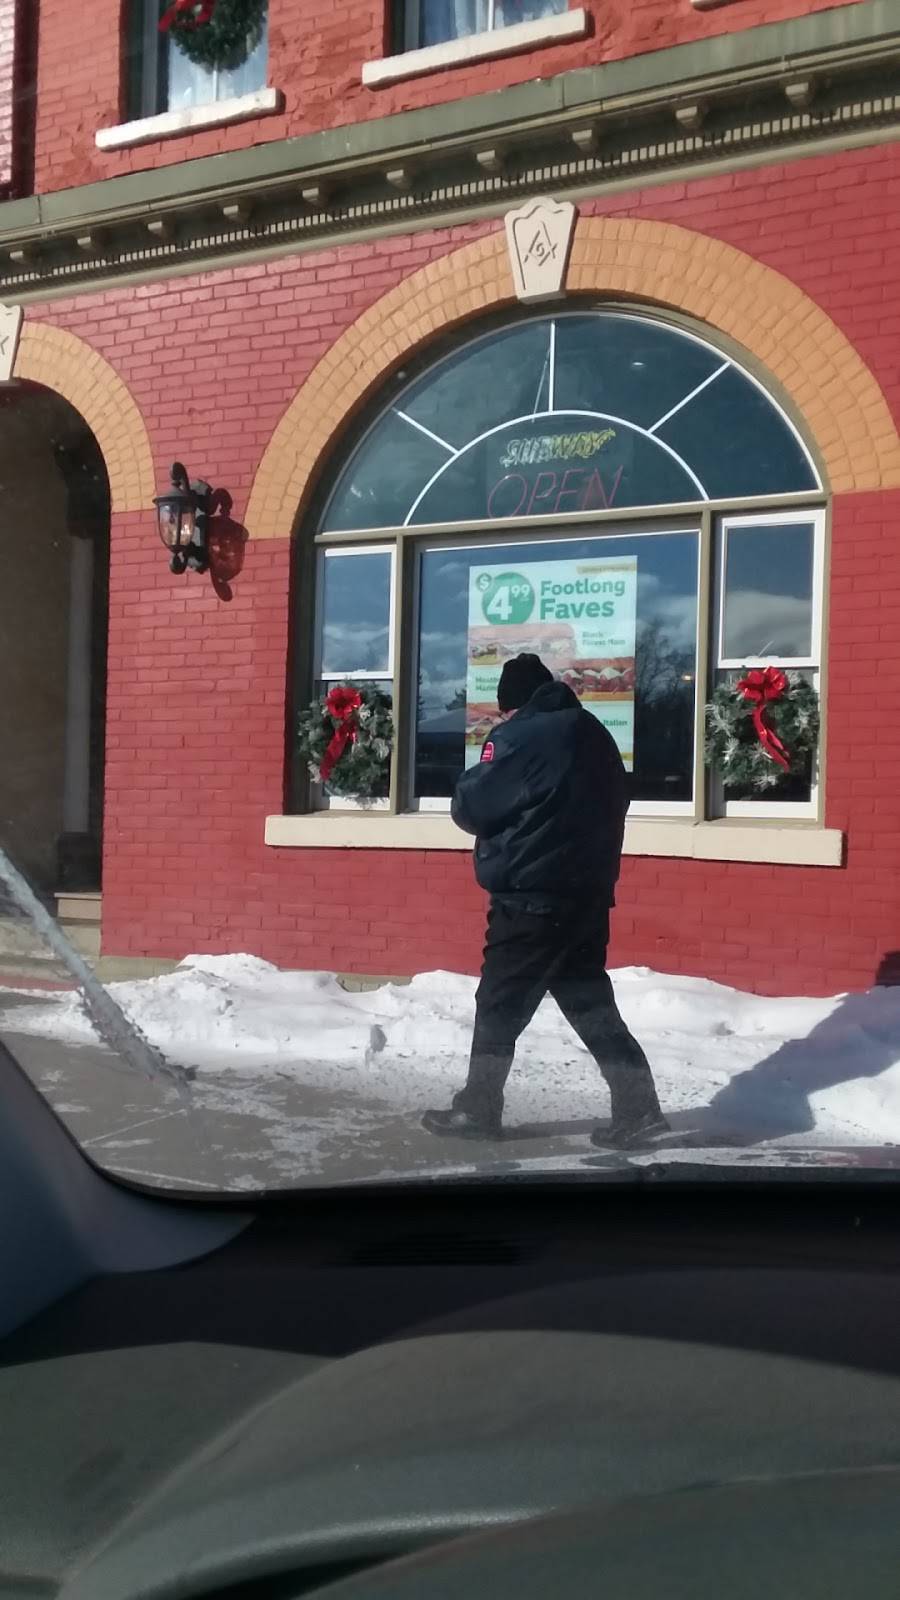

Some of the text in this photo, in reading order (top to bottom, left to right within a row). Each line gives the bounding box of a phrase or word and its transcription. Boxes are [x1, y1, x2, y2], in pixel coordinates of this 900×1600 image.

[487, 464, 624, 518] OPEN
[540, 577, 626, 597] Footlong
[540, 599, 615, 620] Faves
